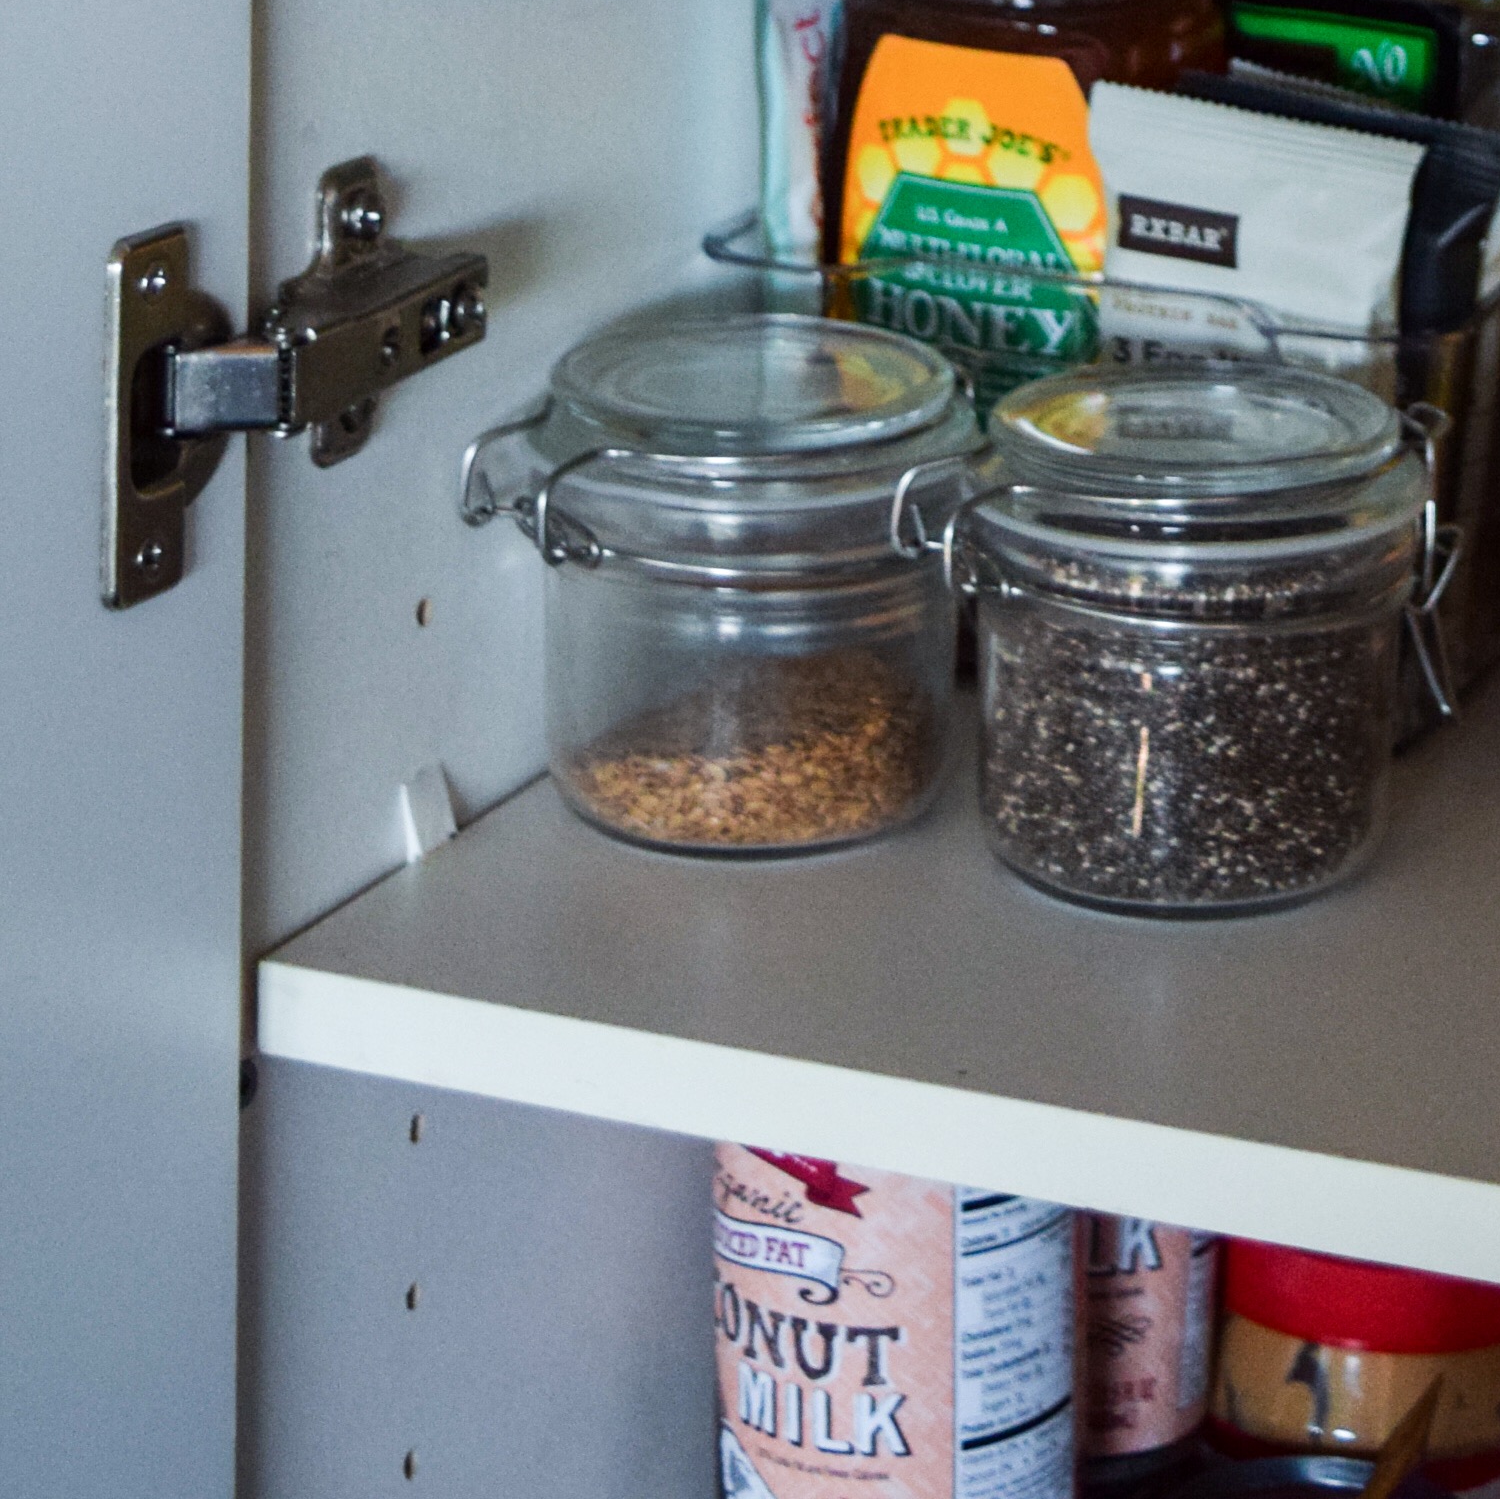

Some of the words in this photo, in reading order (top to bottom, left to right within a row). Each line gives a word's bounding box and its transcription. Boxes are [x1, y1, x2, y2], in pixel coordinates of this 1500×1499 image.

[879, 115, 971, 143] TRADER
[992, 217, 1009, 235] A
[1128, 212, 1223, 252] RXBAR
[866, 277, 1076, 355] HONEY
[1112, 335, 1133, 365] 3
[764, 1236, 811, 1269] FAT
[718, 1282, 900, 1388] ONUT
[737, 1360, 913, 1458] MILK
